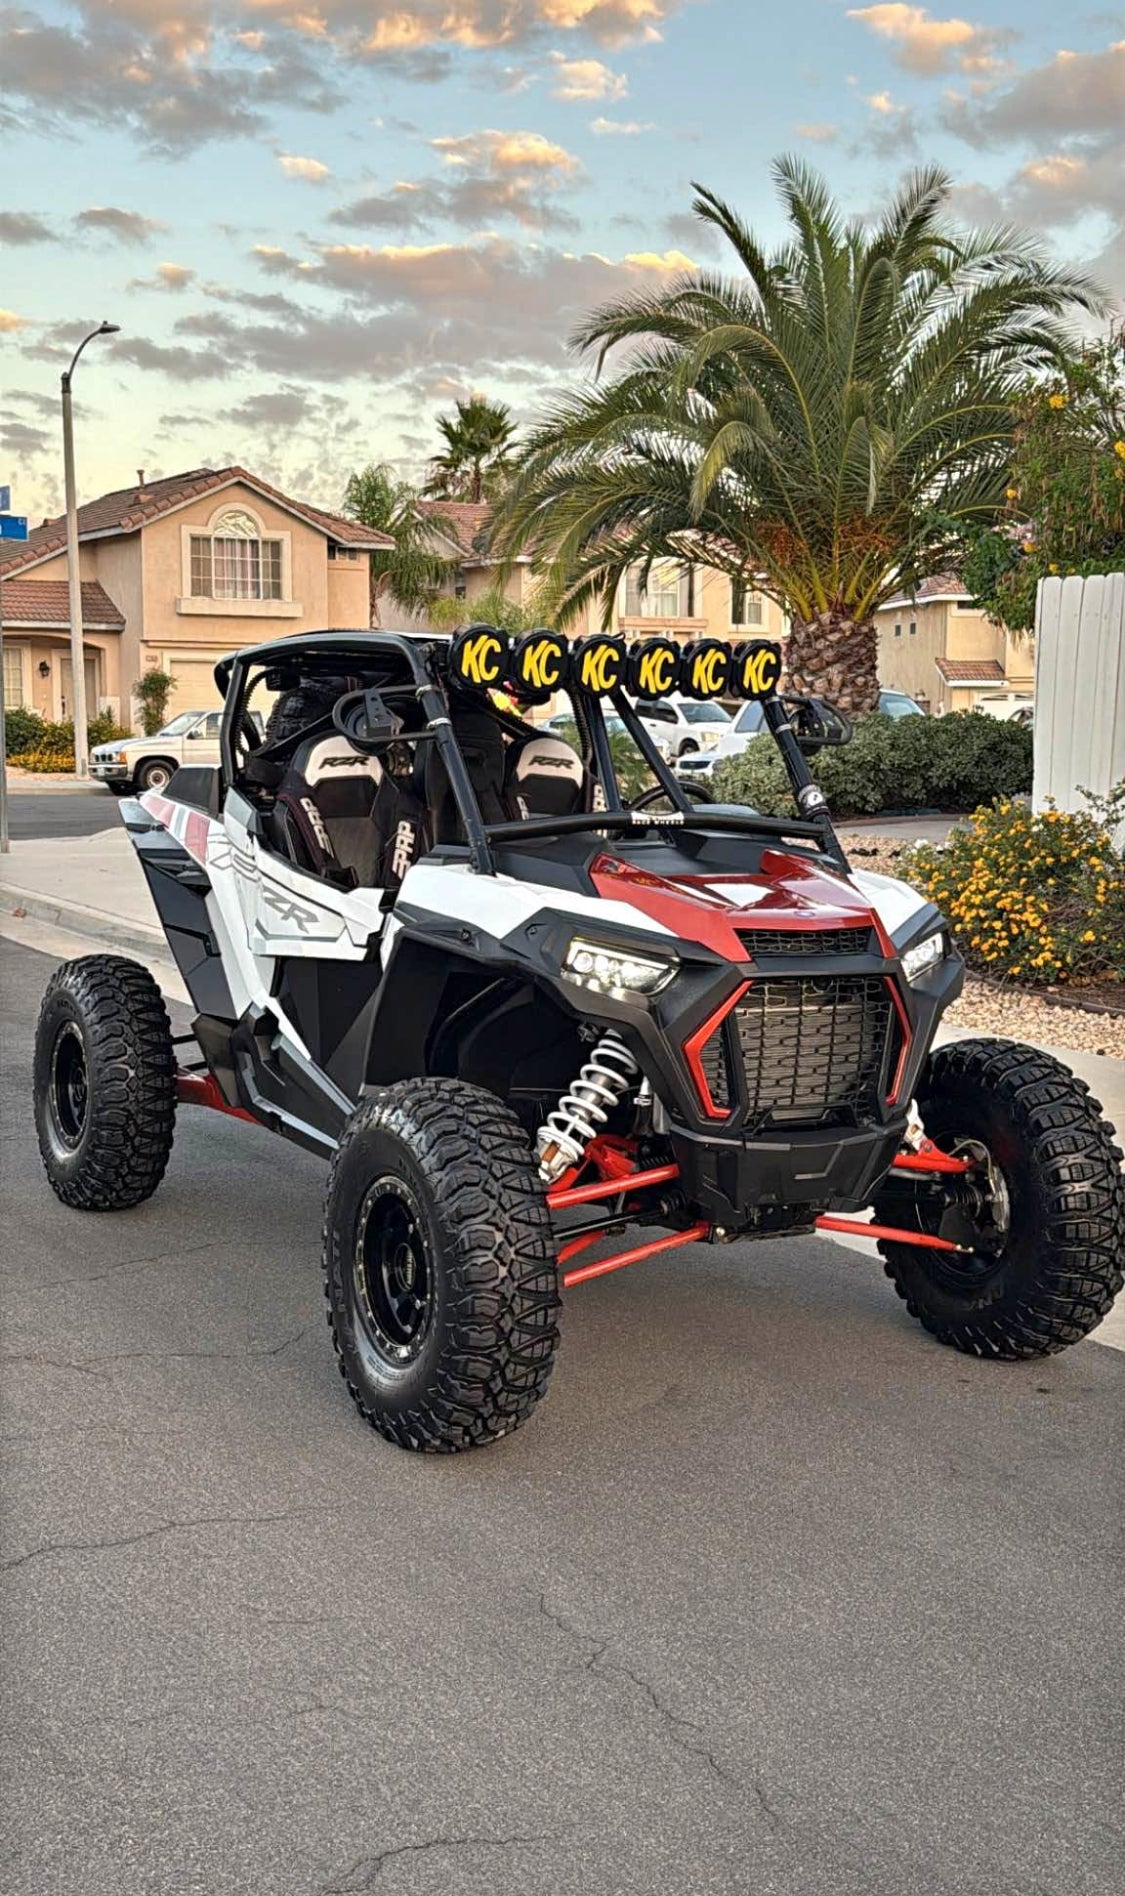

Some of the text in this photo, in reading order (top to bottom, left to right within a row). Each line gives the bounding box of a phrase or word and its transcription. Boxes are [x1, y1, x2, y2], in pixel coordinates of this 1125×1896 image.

[461, 635, 501, 683] KC
[522, 640, 562, 688] KC
[581, 645, 620, 691] KC
[639, 648, 674, 692] KC
[692, 649, 727, 693] KC
[743, 650, 777, 693] KC
